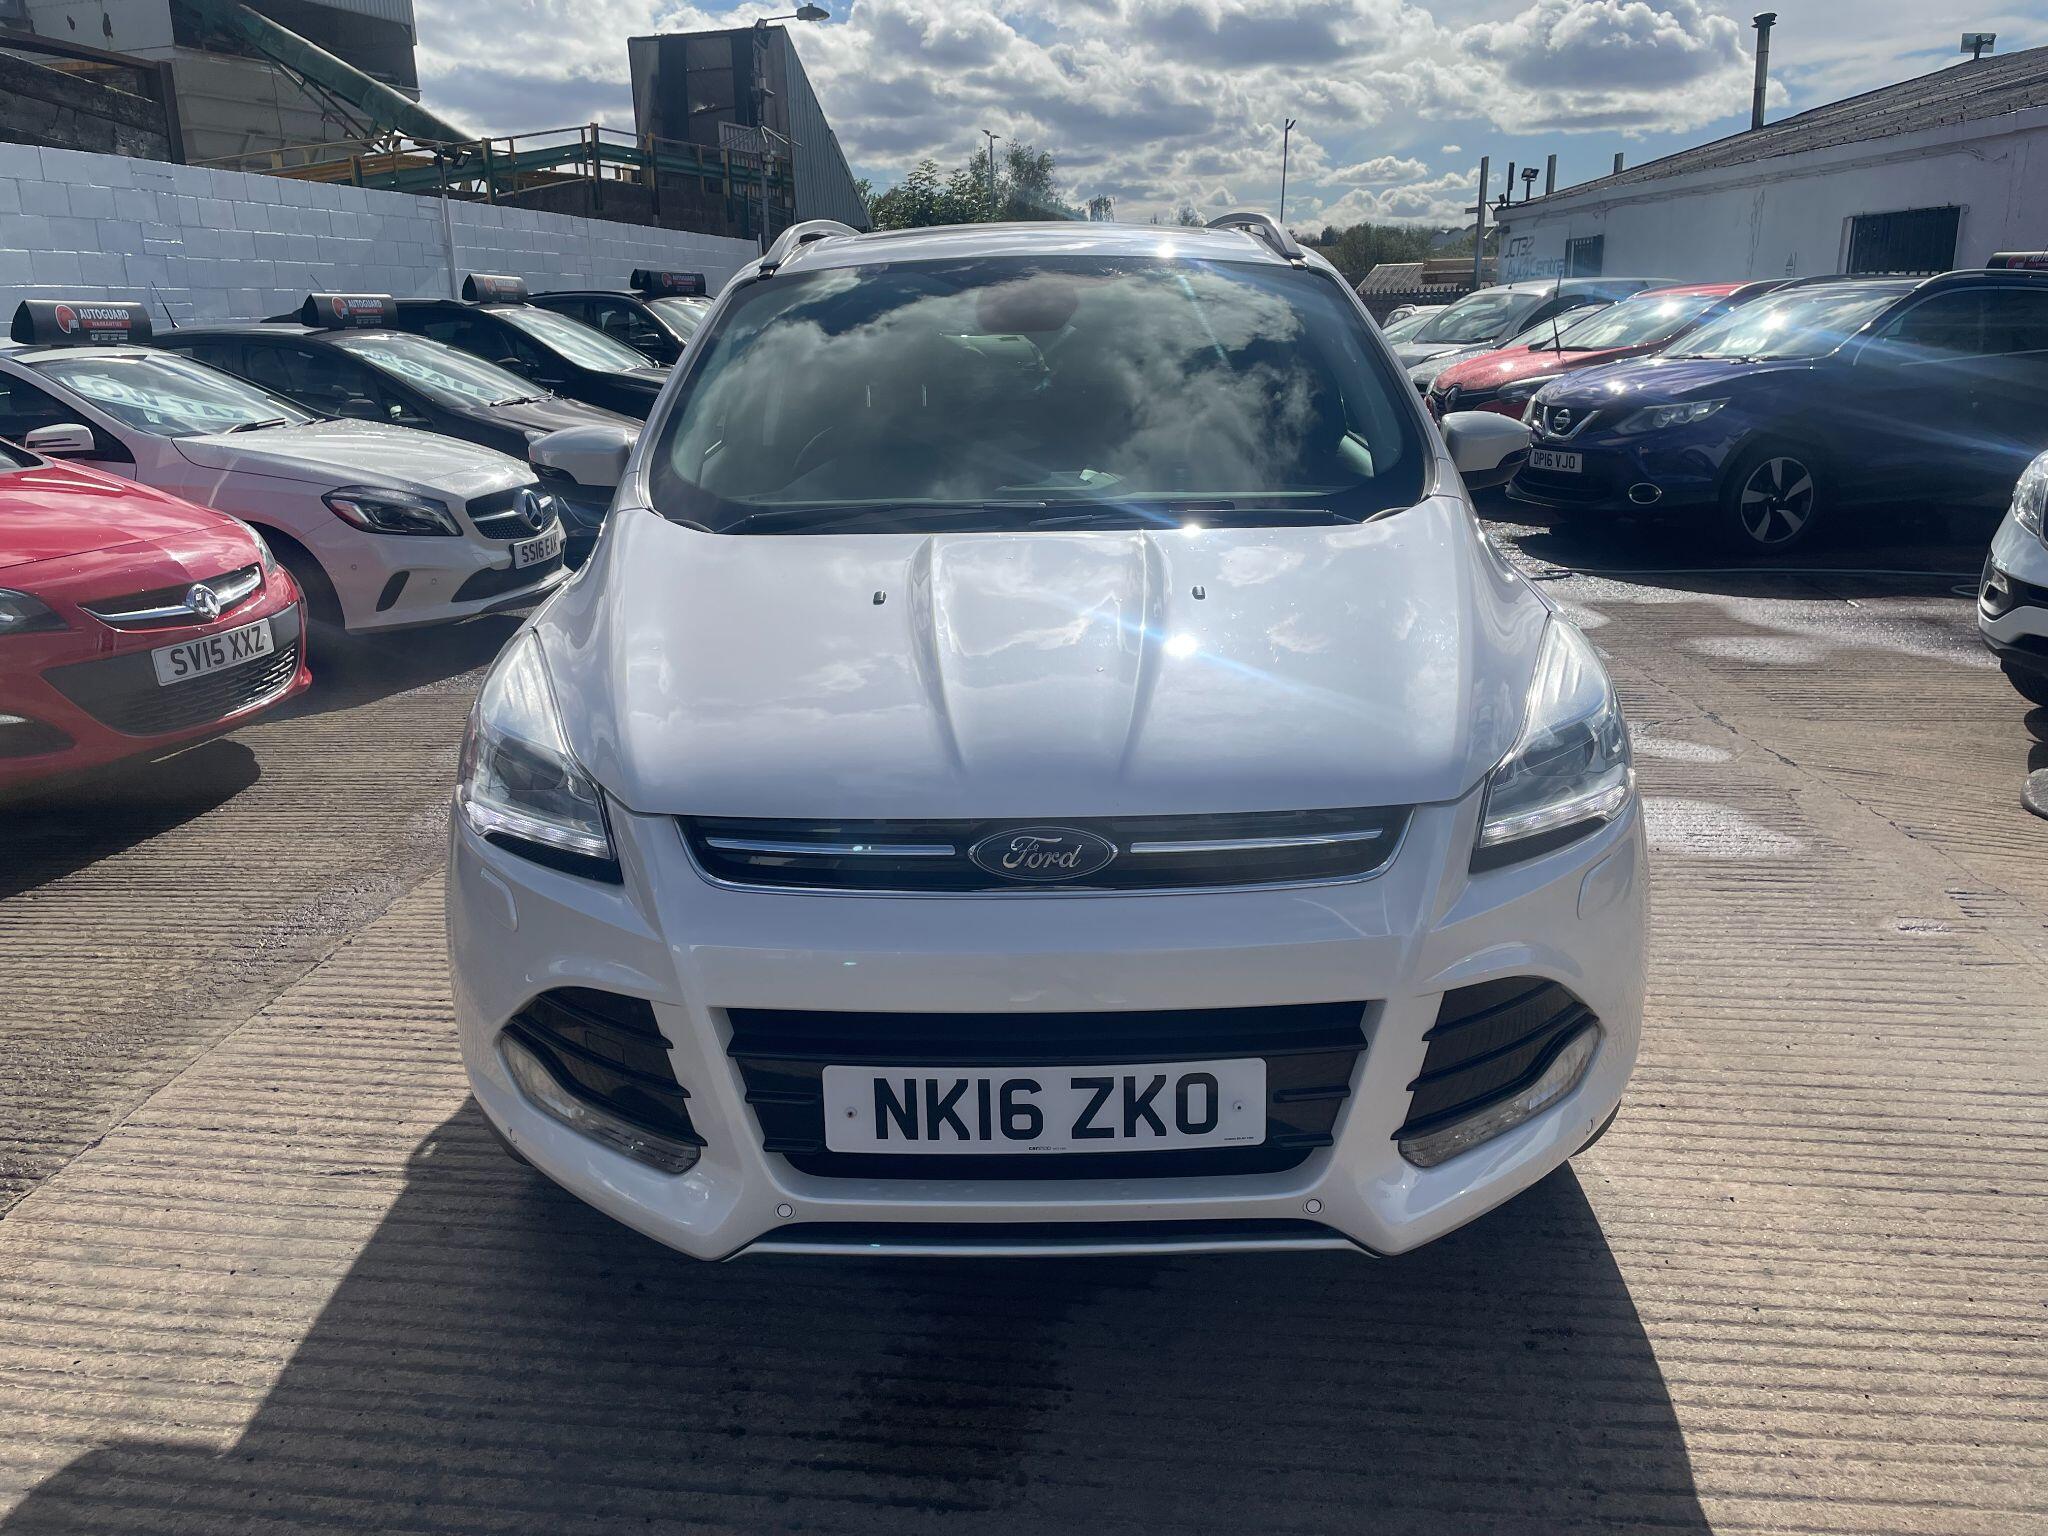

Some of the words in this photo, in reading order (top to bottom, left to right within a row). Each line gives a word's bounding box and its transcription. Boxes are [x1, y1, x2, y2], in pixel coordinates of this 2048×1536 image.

[79, 308, 130, 320] AUTOGUARD
[65, 374, 160, 407] LOW
[1533, 451, 1553, 467] DP16
[1555, 454, 1576, 469] VJO
[521, 540, 545, 563] SS16
[170, 637, 226, 676] SV15
[227, 625, 265, 661] XXZ
[1002, 835, 1083, 869] Ford
[872, 1076, 1044, 1141] NK16
[1070, 1071, 1219, 1139] ZKO
